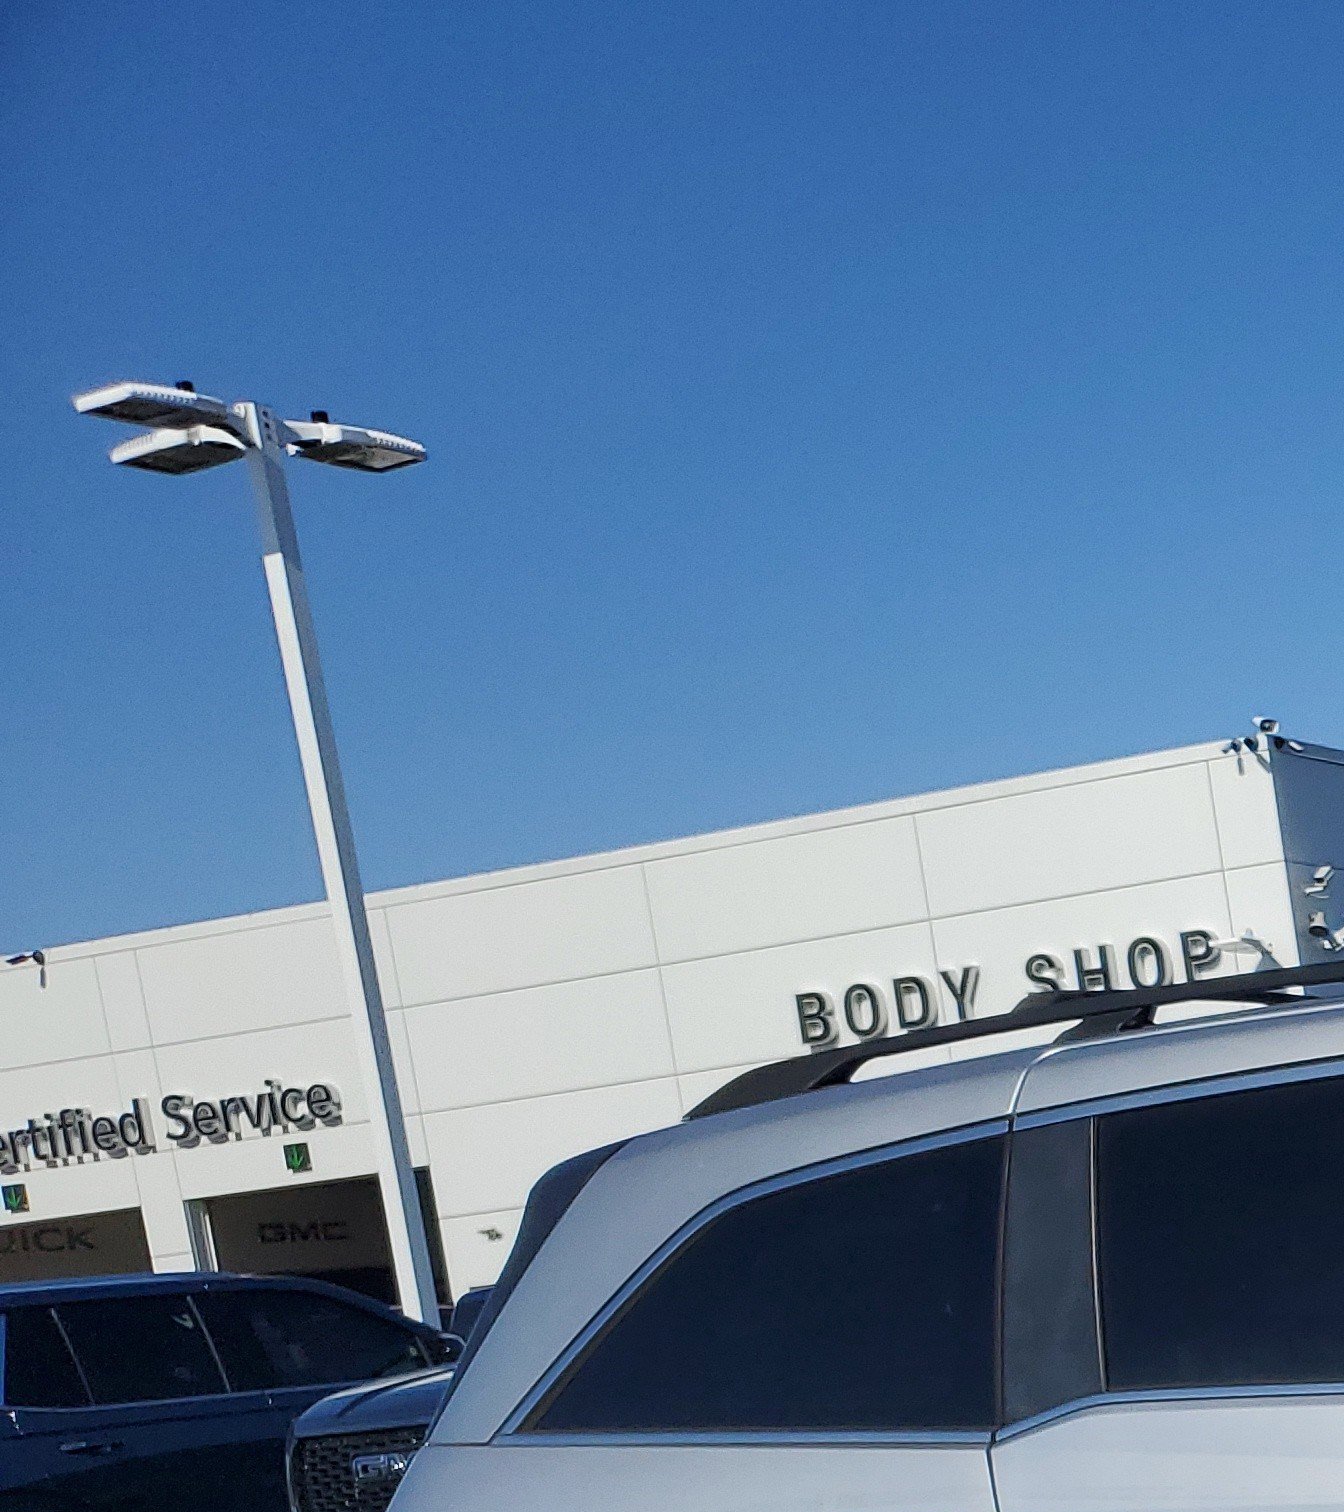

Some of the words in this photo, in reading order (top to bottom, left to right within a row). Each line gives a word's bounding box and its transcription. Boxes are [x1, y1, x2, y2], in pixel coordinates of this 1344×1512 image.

[795, 965, 980, 1048] BODY
[1025, 929, 1220, 993] SHOP
[162, 1079, 339, 1142] Service
[259, 1222, 346, 1242] GMC
